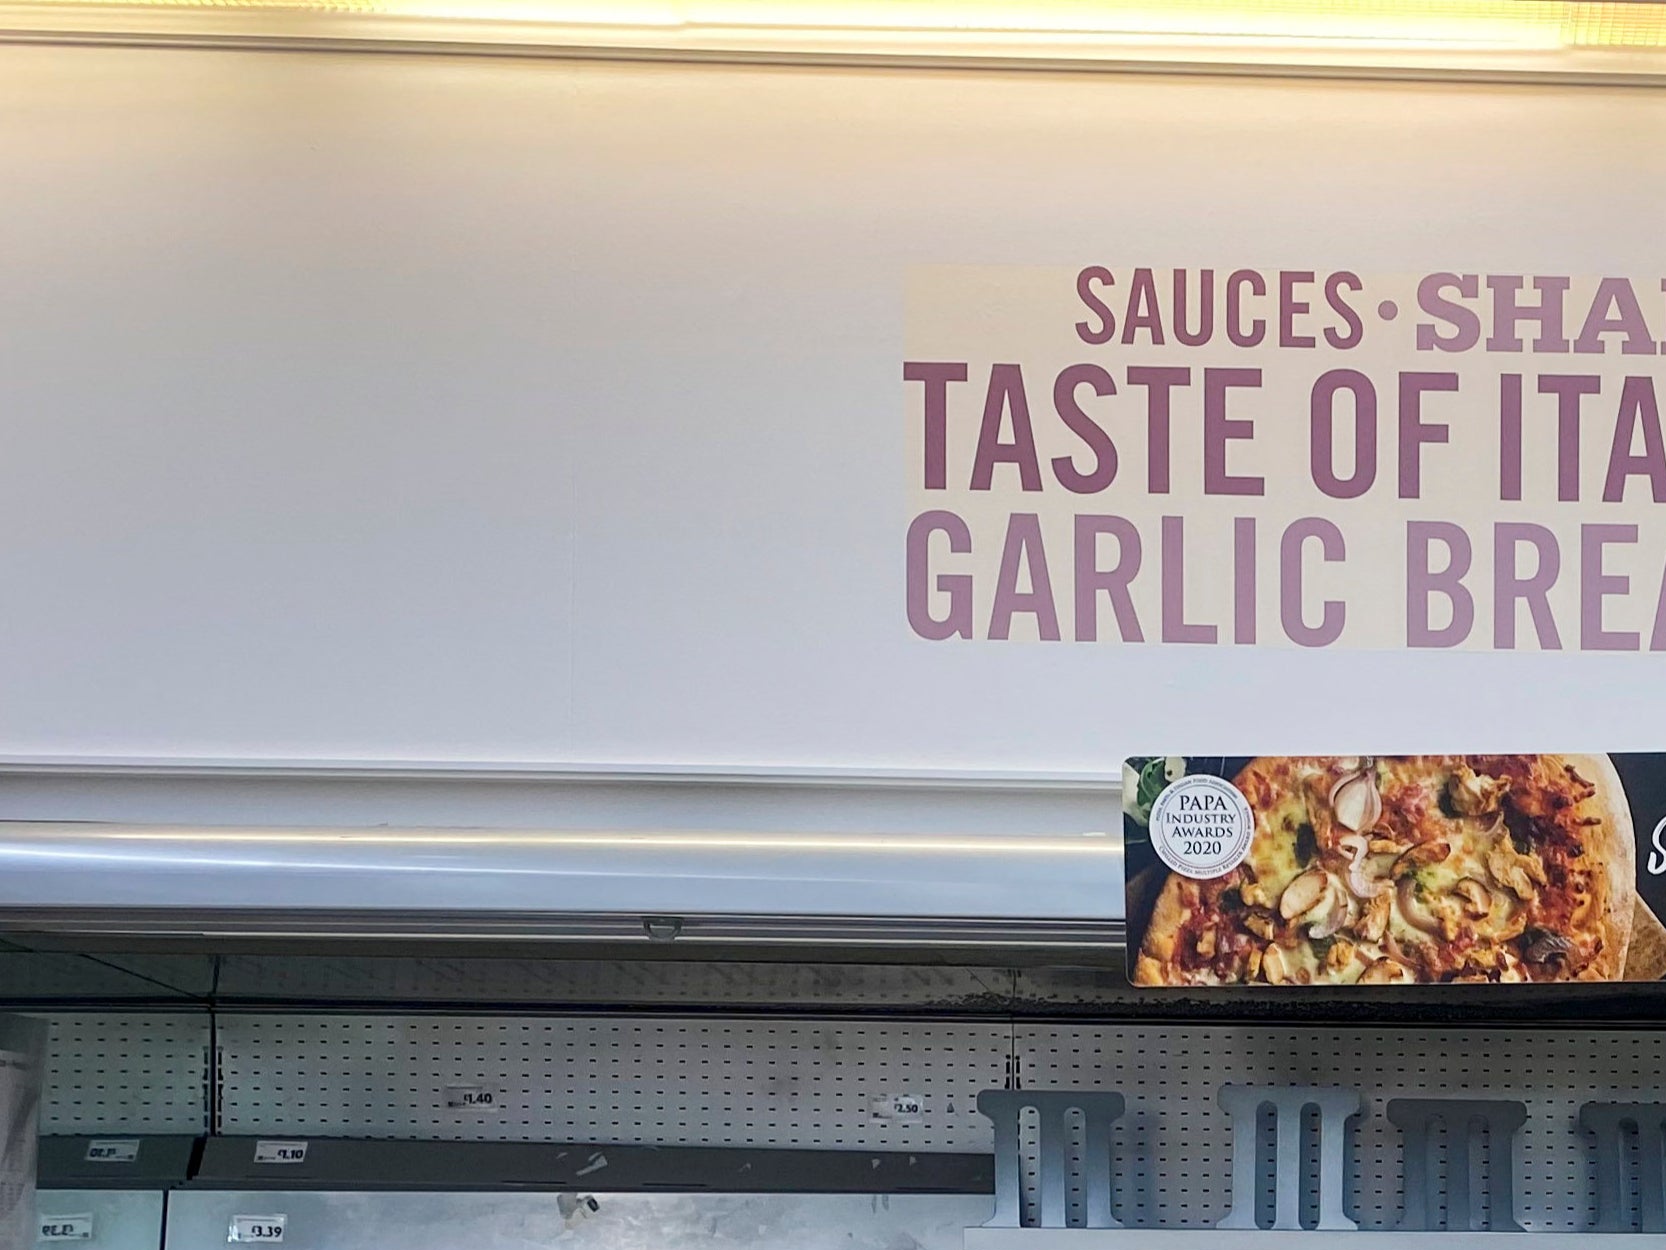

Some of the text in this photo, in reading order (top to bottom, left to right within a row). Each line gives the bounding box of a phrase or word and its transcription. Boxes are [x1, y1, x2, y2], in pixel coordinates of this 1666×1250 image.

[1075, 266, 1364, 350] SAUCES
[903, 362, 1265, 496] TASTE
[1309, 369, 1459, 500] OF
[905, 510, 1347, 648] GARLIC
[1179, 794, 1228, 811] PAPA
[1166, 812, 1236, 825] INDUSTRY
[1171, 825, 1234, 838] AWARDS
[1183, 840, 1222, 856] 2020
